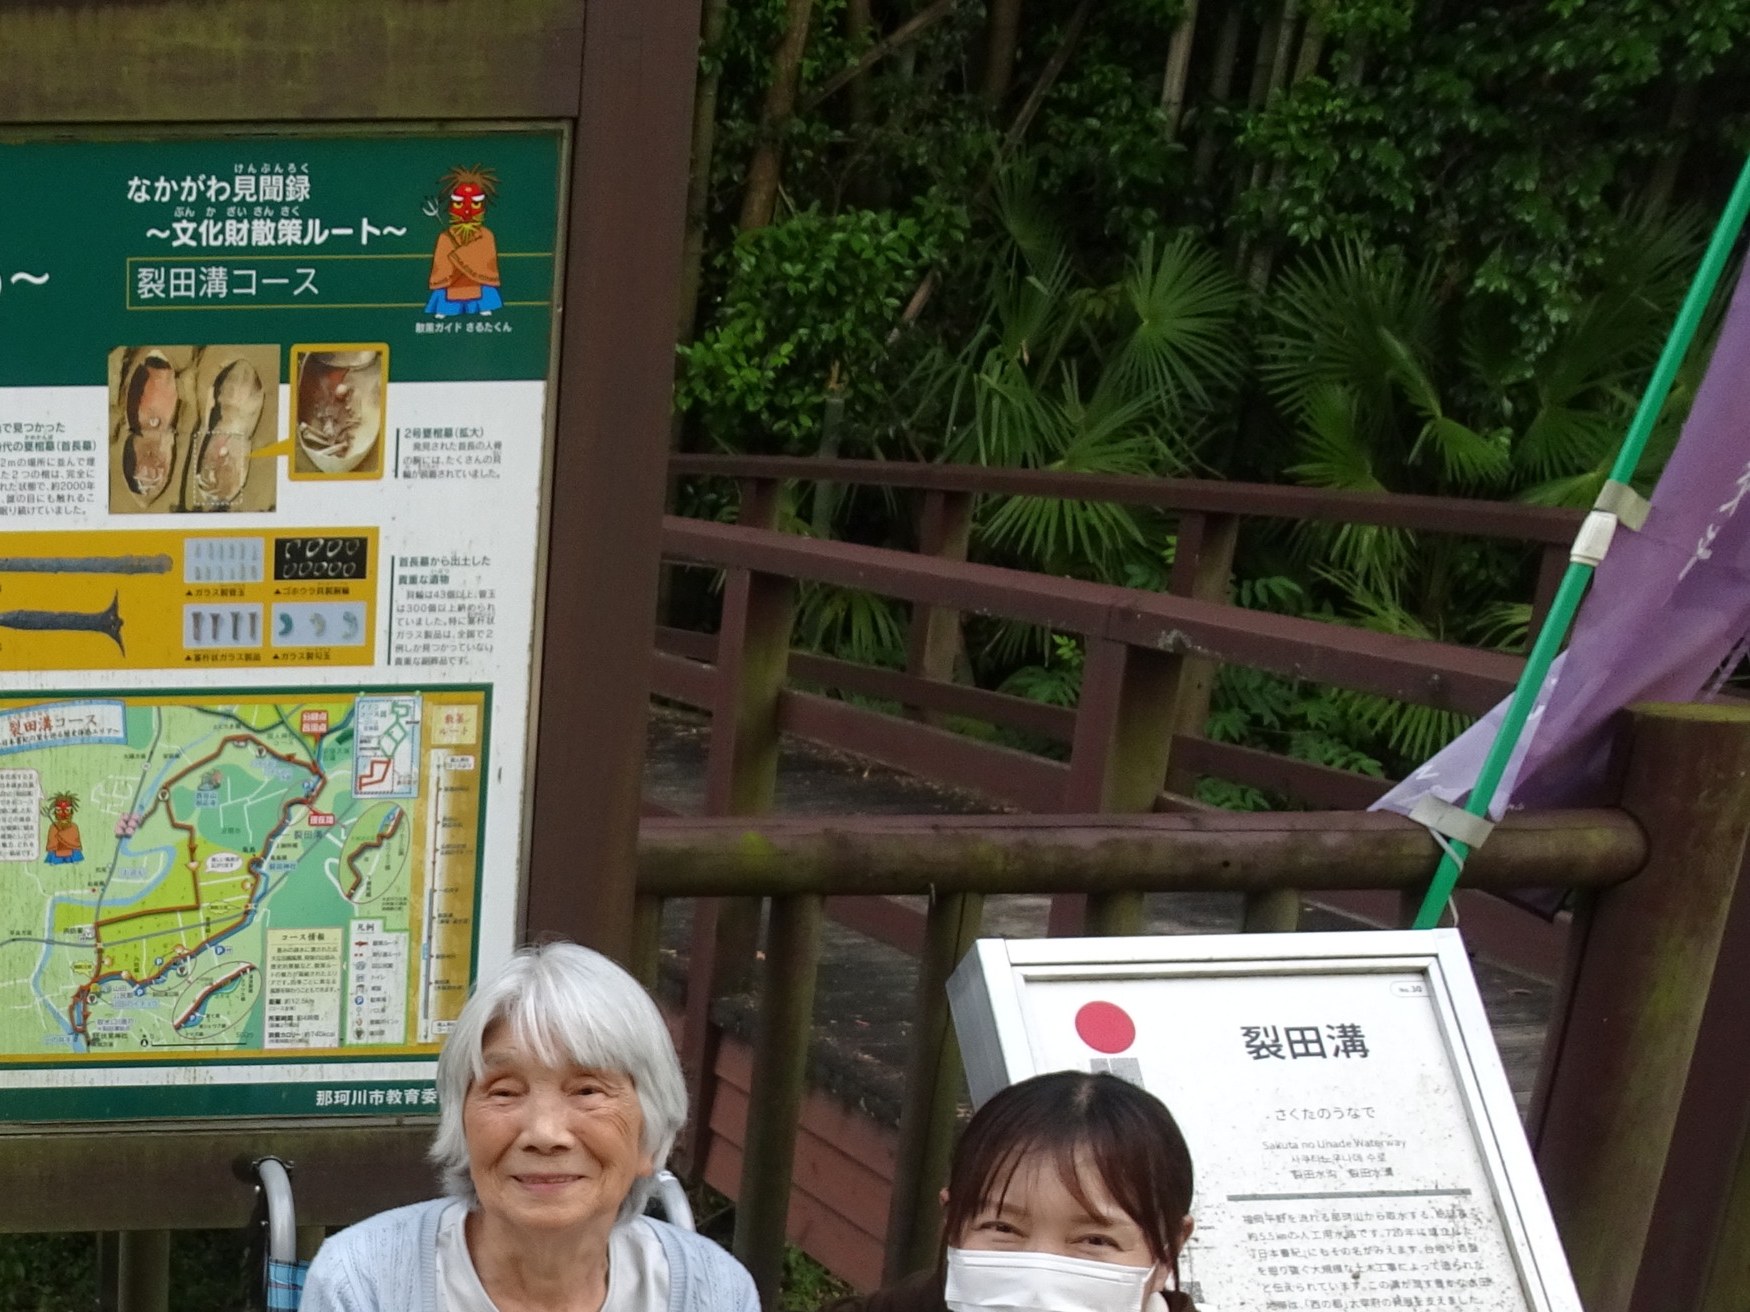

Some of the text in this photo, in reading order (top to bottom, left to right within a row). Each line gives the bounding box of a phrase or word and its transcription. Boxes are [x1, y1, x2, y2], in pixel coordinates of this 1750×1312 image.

[126, 174, 311, 203] なかがわ見聞録
[136, 267, 320, 300] 裂田溝コース
[1240, 1022, 1371, 1062] 裂田溝
[1274, 1106, 1376, 1121] さくたのうなで
[1262, 1140, 1299, 1150] Sakuta
[1353, 1138, 1407, 1149] Waterway
